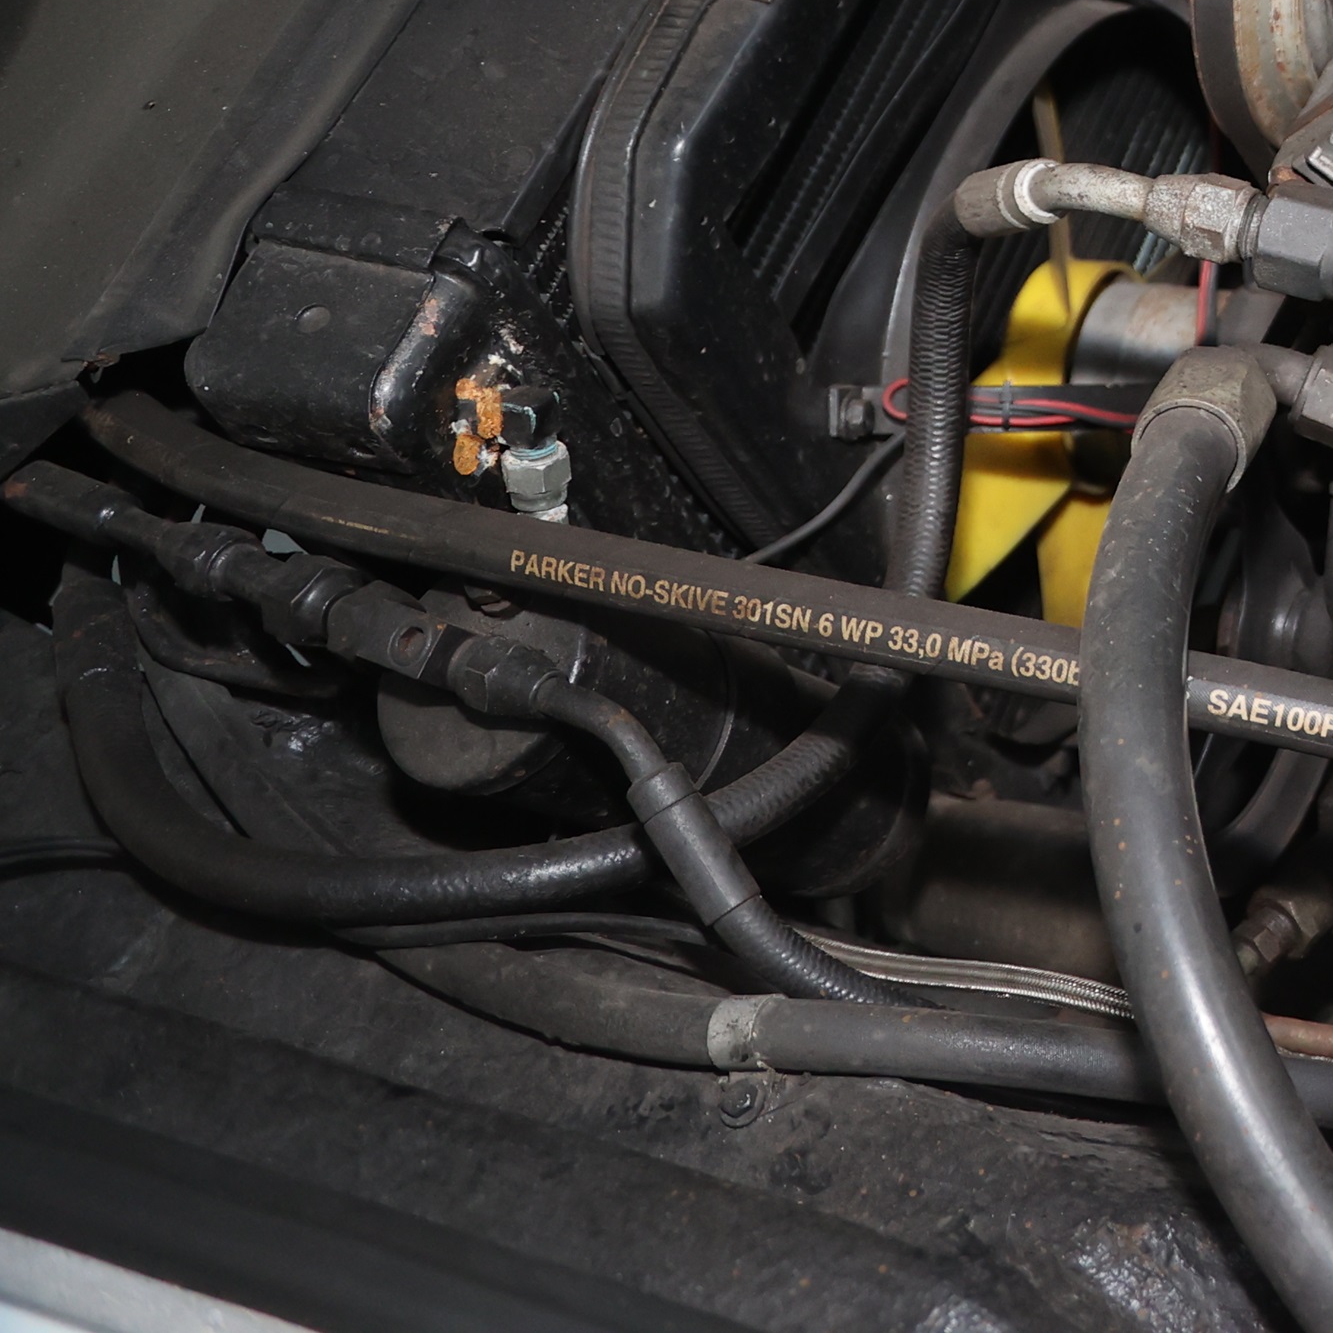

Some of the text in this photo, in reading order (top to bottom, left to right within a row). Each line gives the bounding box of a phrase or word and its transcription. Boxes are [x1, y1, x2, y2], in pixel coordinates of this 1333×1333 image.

[510, 549, 605, 592] PARKER
[610, 571, 729, 616] NO-SKIVE
[840, 615, 883, 646] WP
[887, 626, 942, 659] 33,0
[947, 636, 1004, 671] MPa
